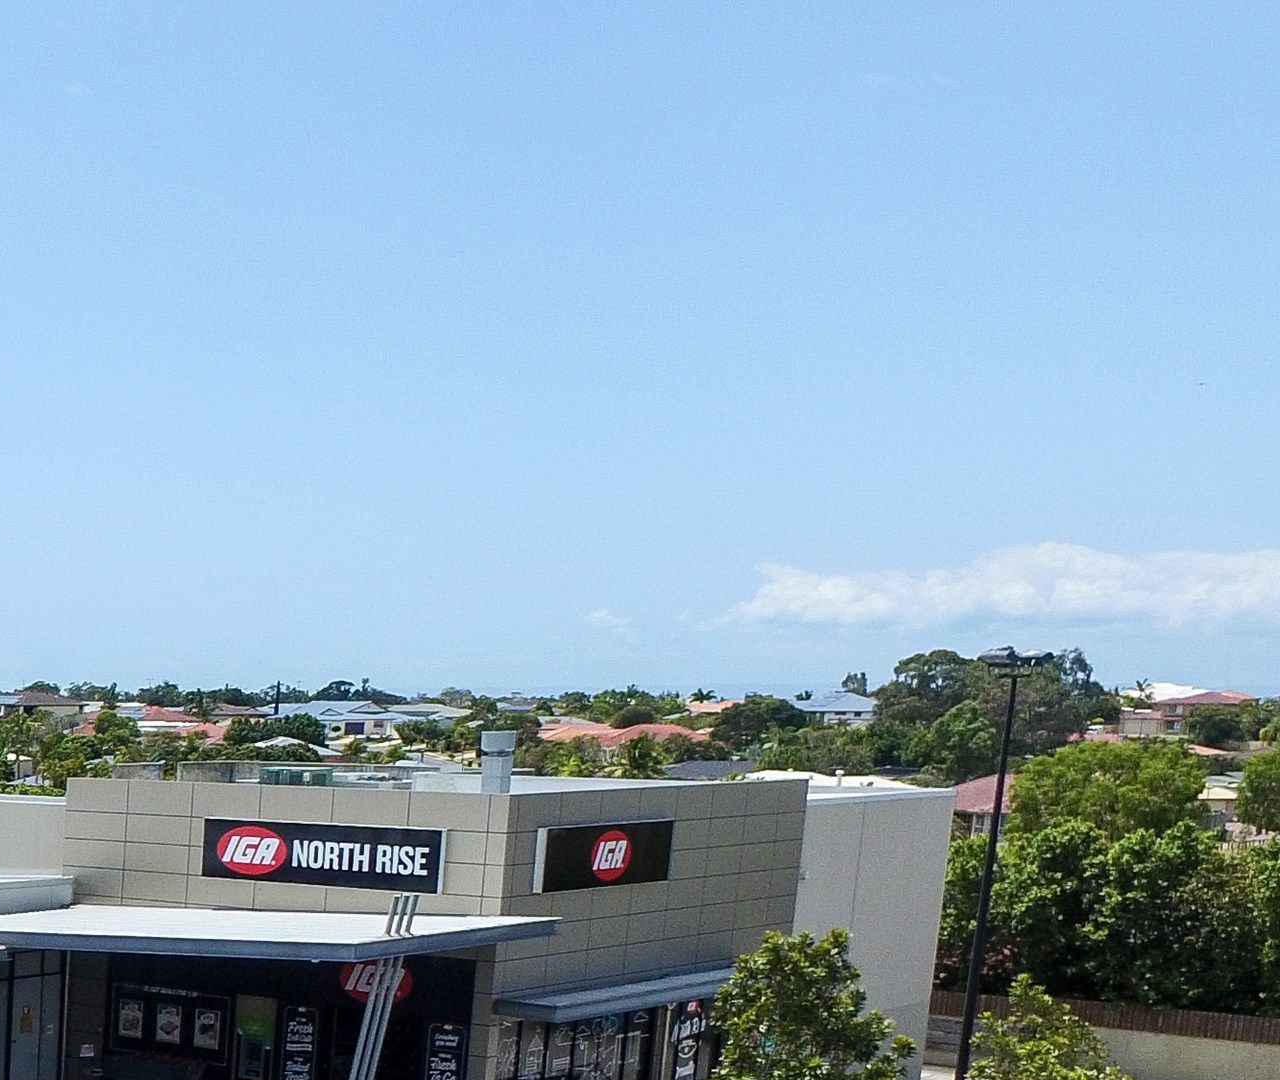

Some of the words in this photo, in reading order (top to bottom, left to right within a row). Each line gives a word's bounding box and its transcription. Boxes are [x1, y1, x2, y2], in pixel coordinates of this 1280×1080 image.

[292, 839, 370, 872] NORTH
[375, 845, 430, 876] RISE
[592, 840, 627, 870] IGA
